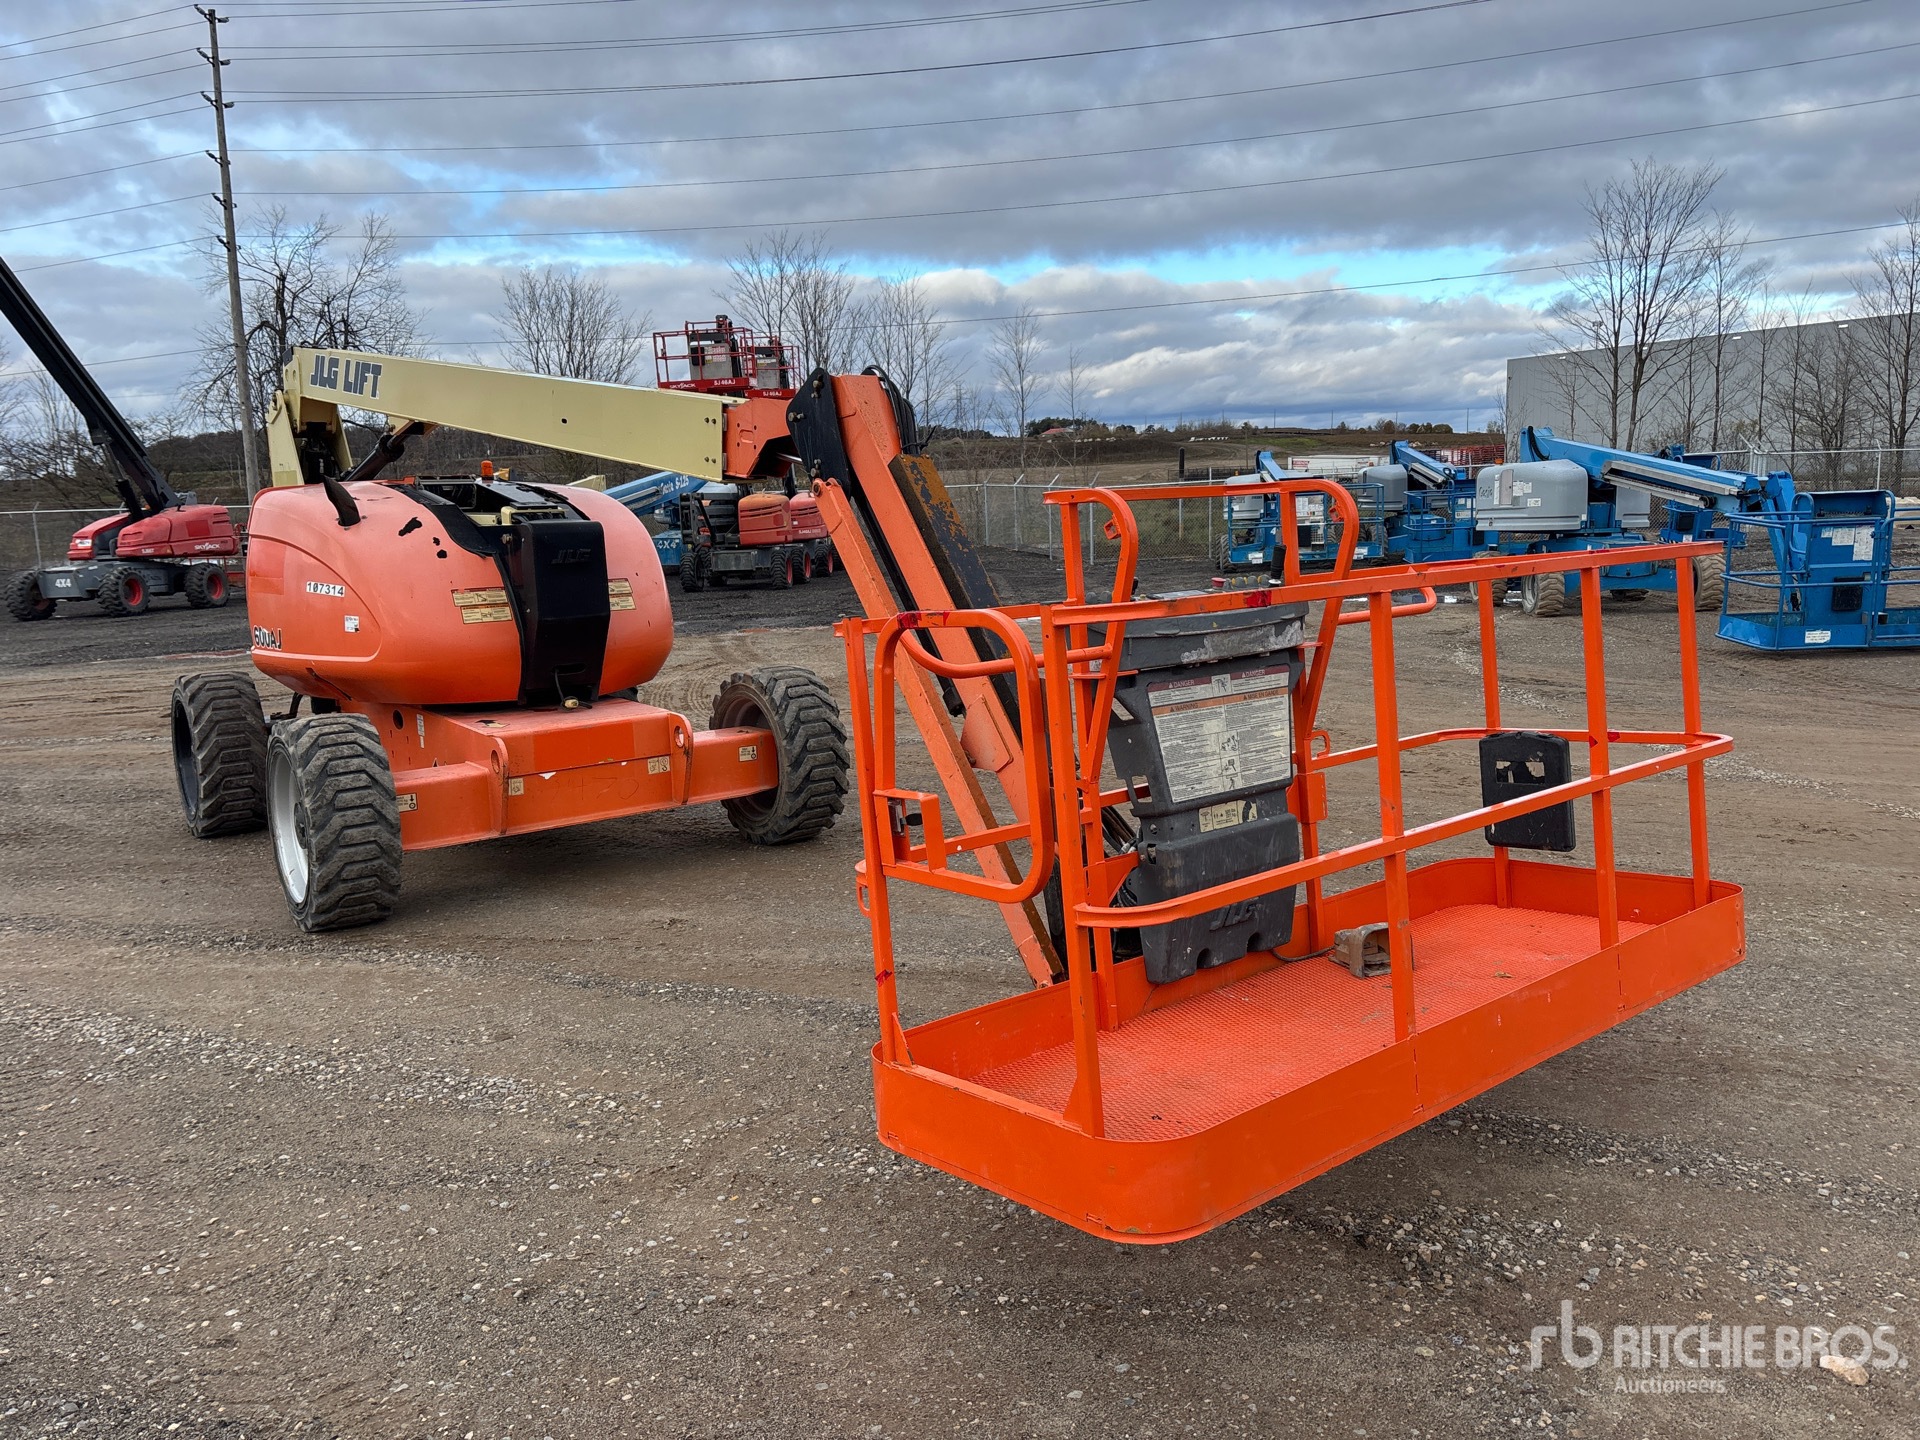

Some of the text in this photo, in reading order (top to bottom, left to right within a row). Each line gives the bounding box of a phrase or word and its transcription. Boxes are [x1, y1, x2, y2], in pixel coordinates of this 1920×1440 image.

[310, 354, 383, 400] JLG LIFT
[55, 578, 72, 588] 4X4
[307, 582, 344, 596] 107314
[1246, 669, 1266, 678] DANGER
[1173, 679, 1195, 688] DANGER
[1174, 702, 1199, 711] WARNING
